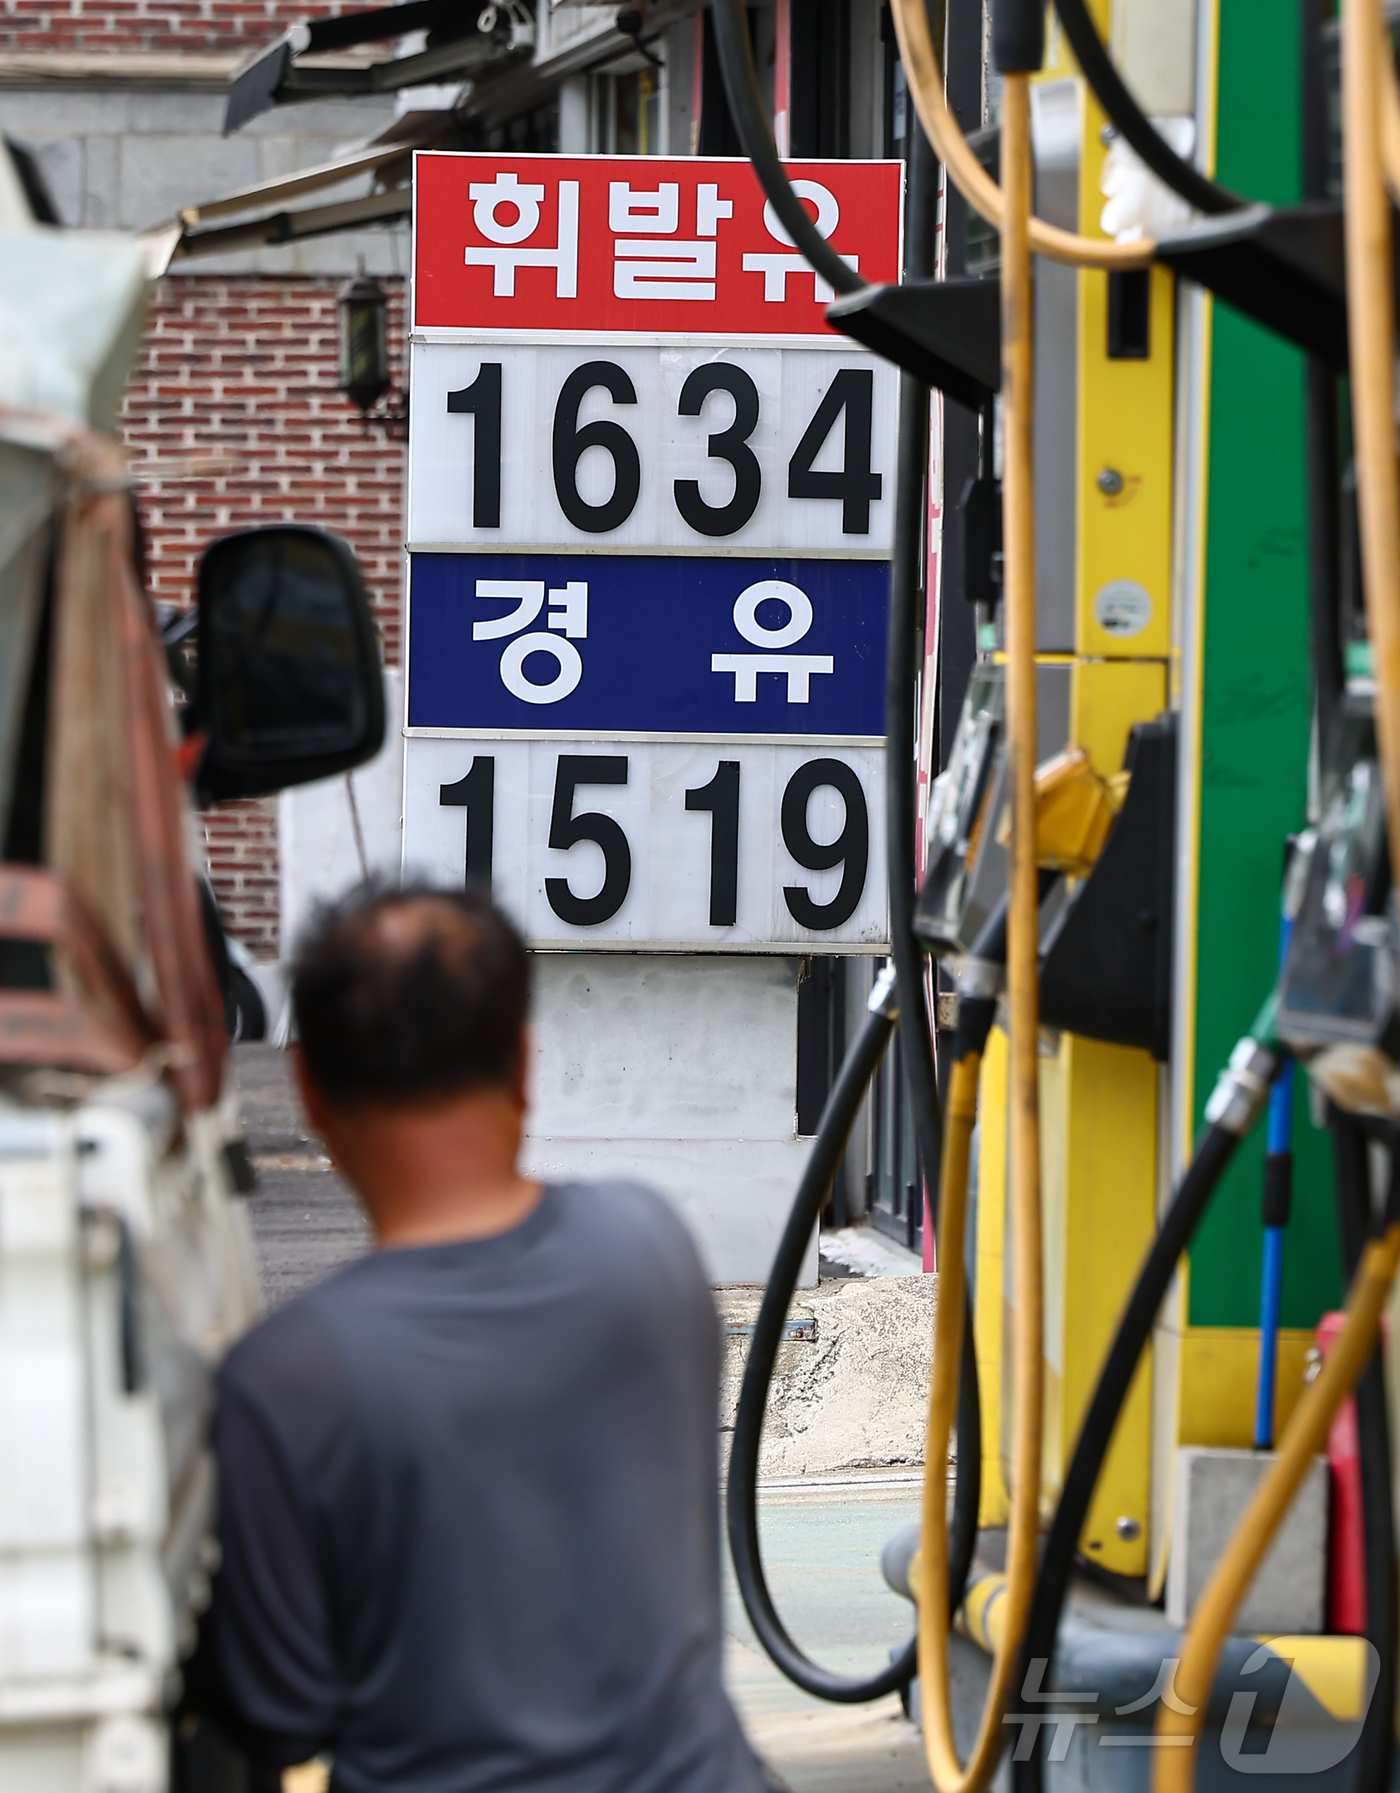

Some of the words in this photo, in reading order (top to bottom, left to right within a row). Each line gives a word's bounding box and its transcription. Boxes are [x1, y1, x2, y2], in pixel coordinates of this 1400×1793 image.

[464, 172, 860, 303] 휘발유
[446, 360, 883, 538] 1634
[472, 579, 835, 705] 경유
[439, 753, 870, 931] 1519
